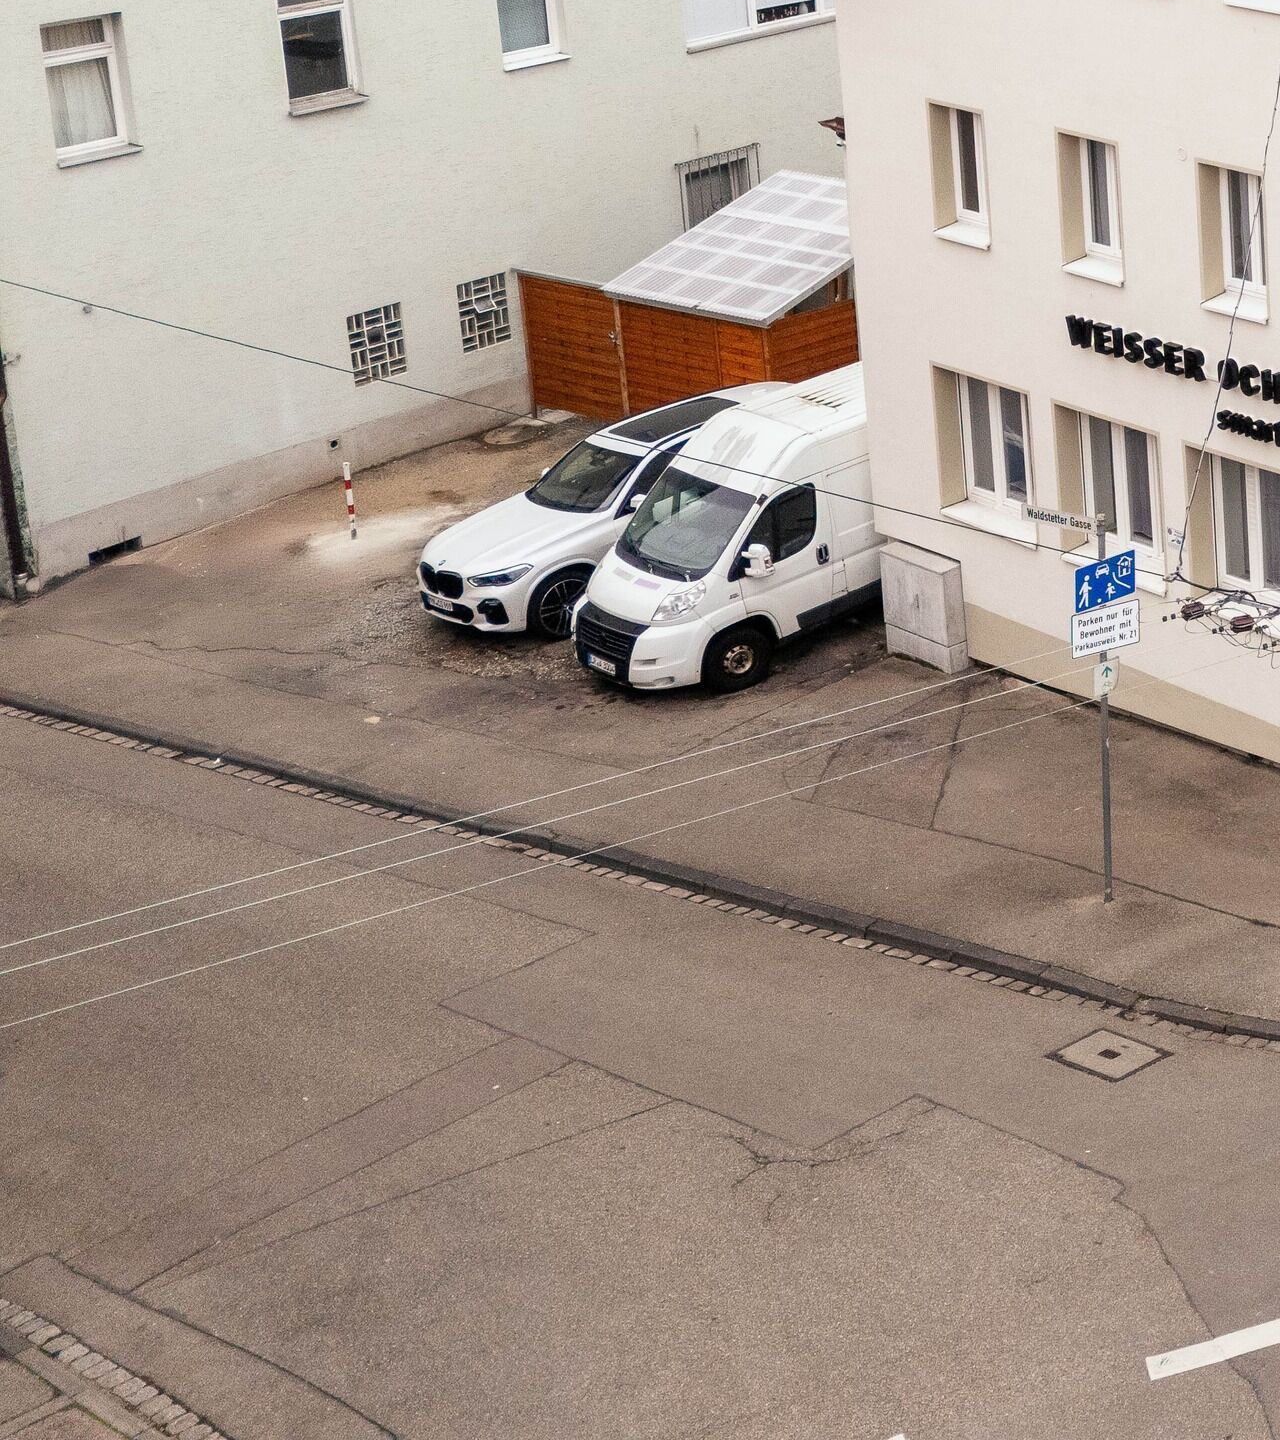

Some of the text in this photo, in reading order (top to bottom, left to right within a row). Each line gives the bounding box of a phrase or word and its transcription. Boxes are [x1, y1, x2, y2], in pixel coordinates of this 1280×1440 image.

[1065, 314, 1206, 382] WEISSER
[1026, 507, 1092, 530] Waldstetter Gasse
[1077, 607, 1133, 627] Parken nur für
[1079, 620, 1131, 639] Bewohner mit
[1074, 635, 1117, 652] Parkausweis
[1118, 633, 1128, 641] Nr.
